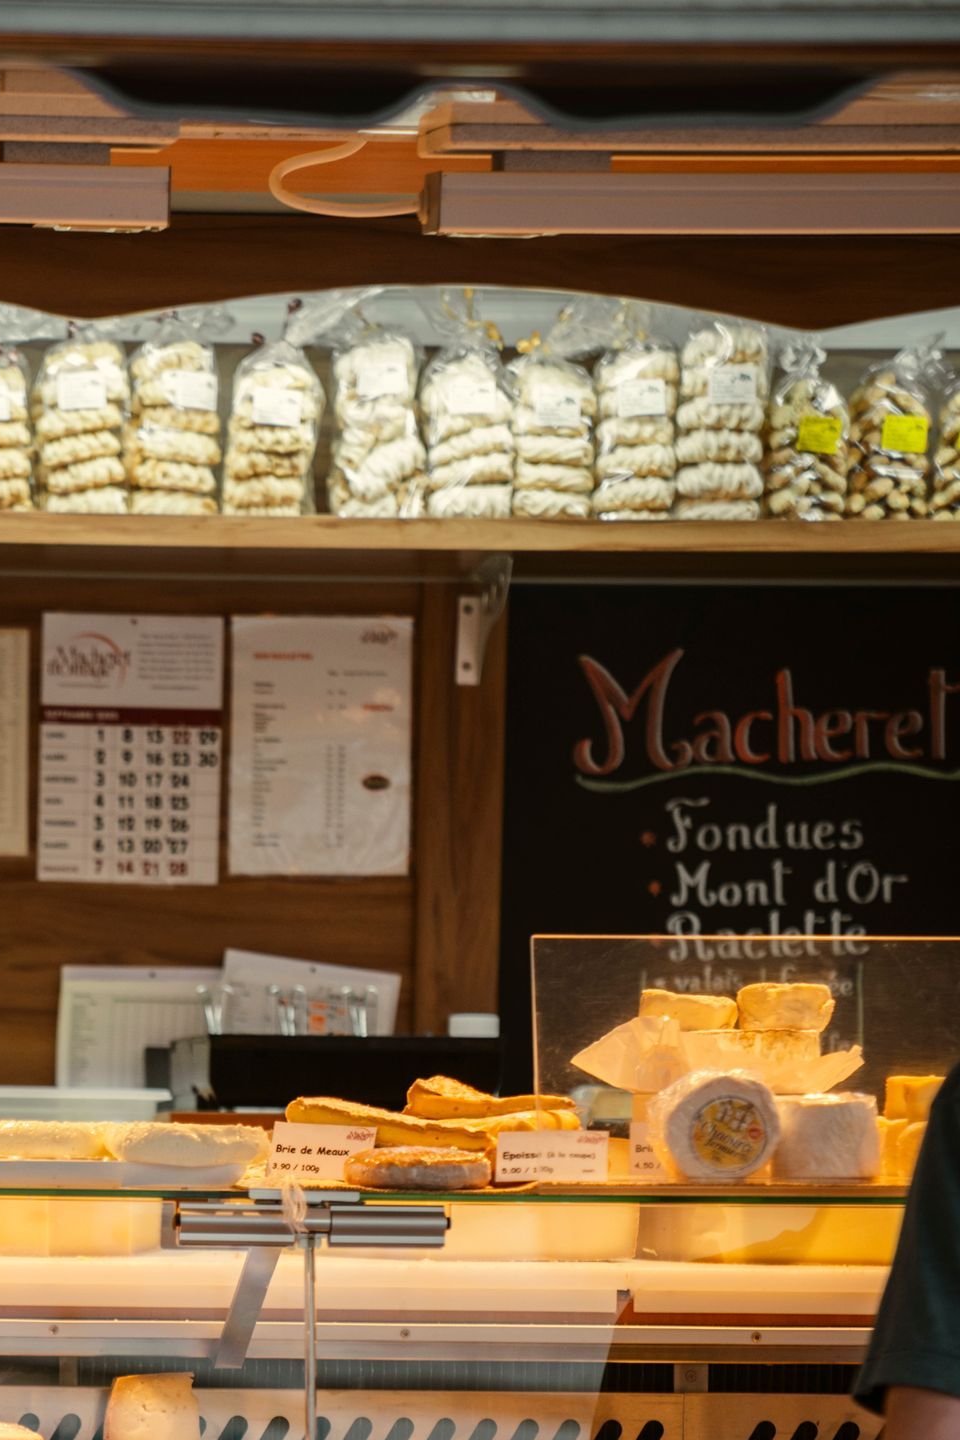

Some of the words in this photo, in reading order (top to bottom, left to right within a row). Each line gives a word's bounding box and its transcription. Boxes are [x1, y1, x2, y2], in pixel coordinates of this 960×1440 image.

[666, 797, 864, 852] Fondues
[670, 859, 792, 907] Mont
[666, 909, 870, 962] Raclette
[276, 1144, 296, 1154] Brie
[300, 1146, 313, 1155] de
[316, 1147, 350, 1157] Meaux
[301, 1163, 320, 1173] 100g
